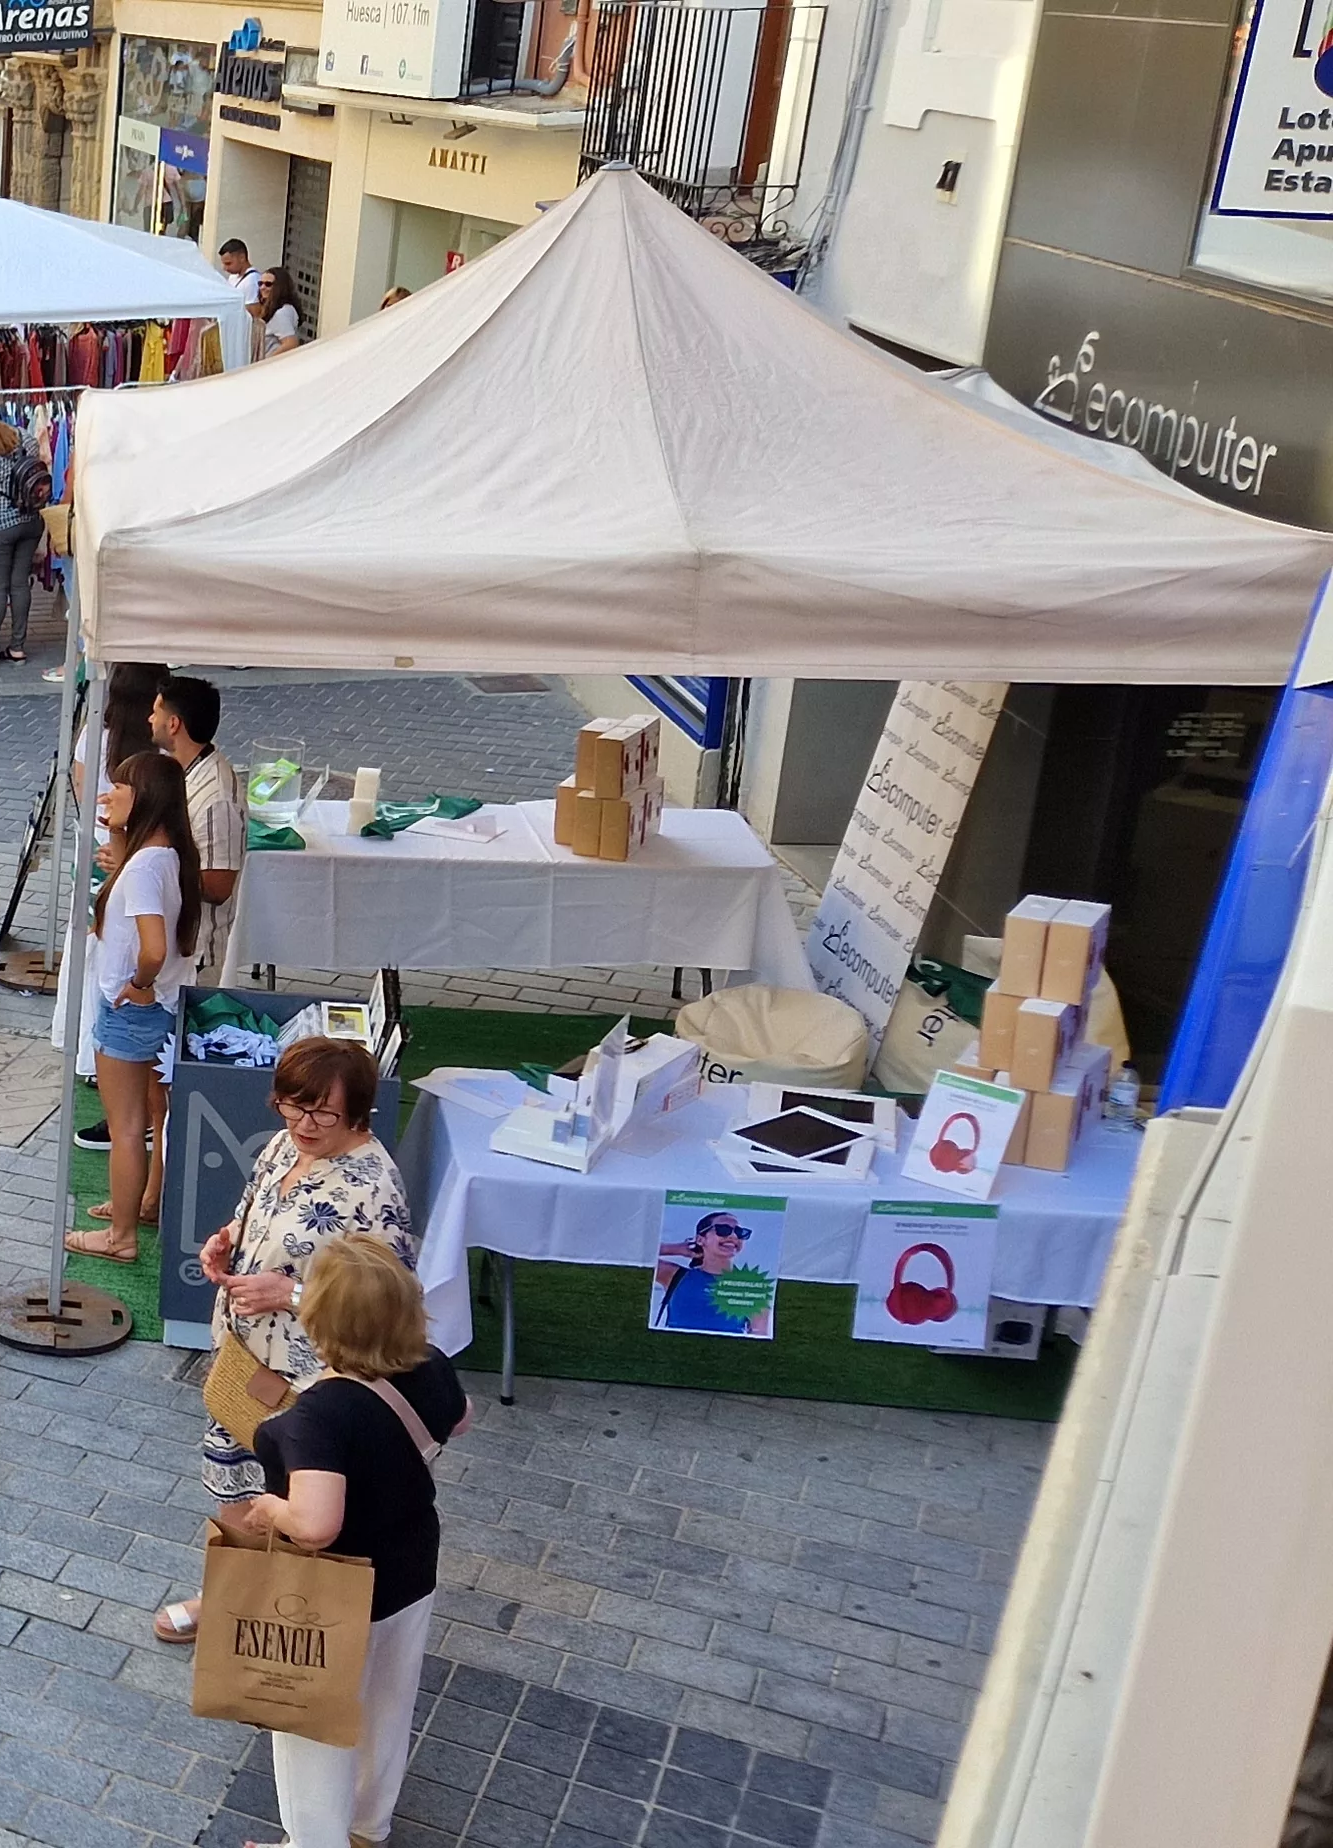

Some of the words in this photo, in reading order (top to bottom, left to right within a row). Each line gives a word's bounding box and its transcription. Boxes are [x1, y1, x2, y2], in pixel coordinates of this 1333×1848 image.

[346, 1, 382, 24] Huesca
[391, 3, 430, 27] 107.1fm
[15, 31, 43, 43] ÓPTICO
[51, 29, 88, 40] AUDITIVO
[1278, 107, 1333, 130] Lot
[428, 147, 487, 174] AMATTI
[1085, 382, 1277, 496] ecomputer
[880, 779, 943, 837] ecomputer
[839, 941, 899, 1008] ecomputer
[234, 1617, 327, 1669] ESENCIA
